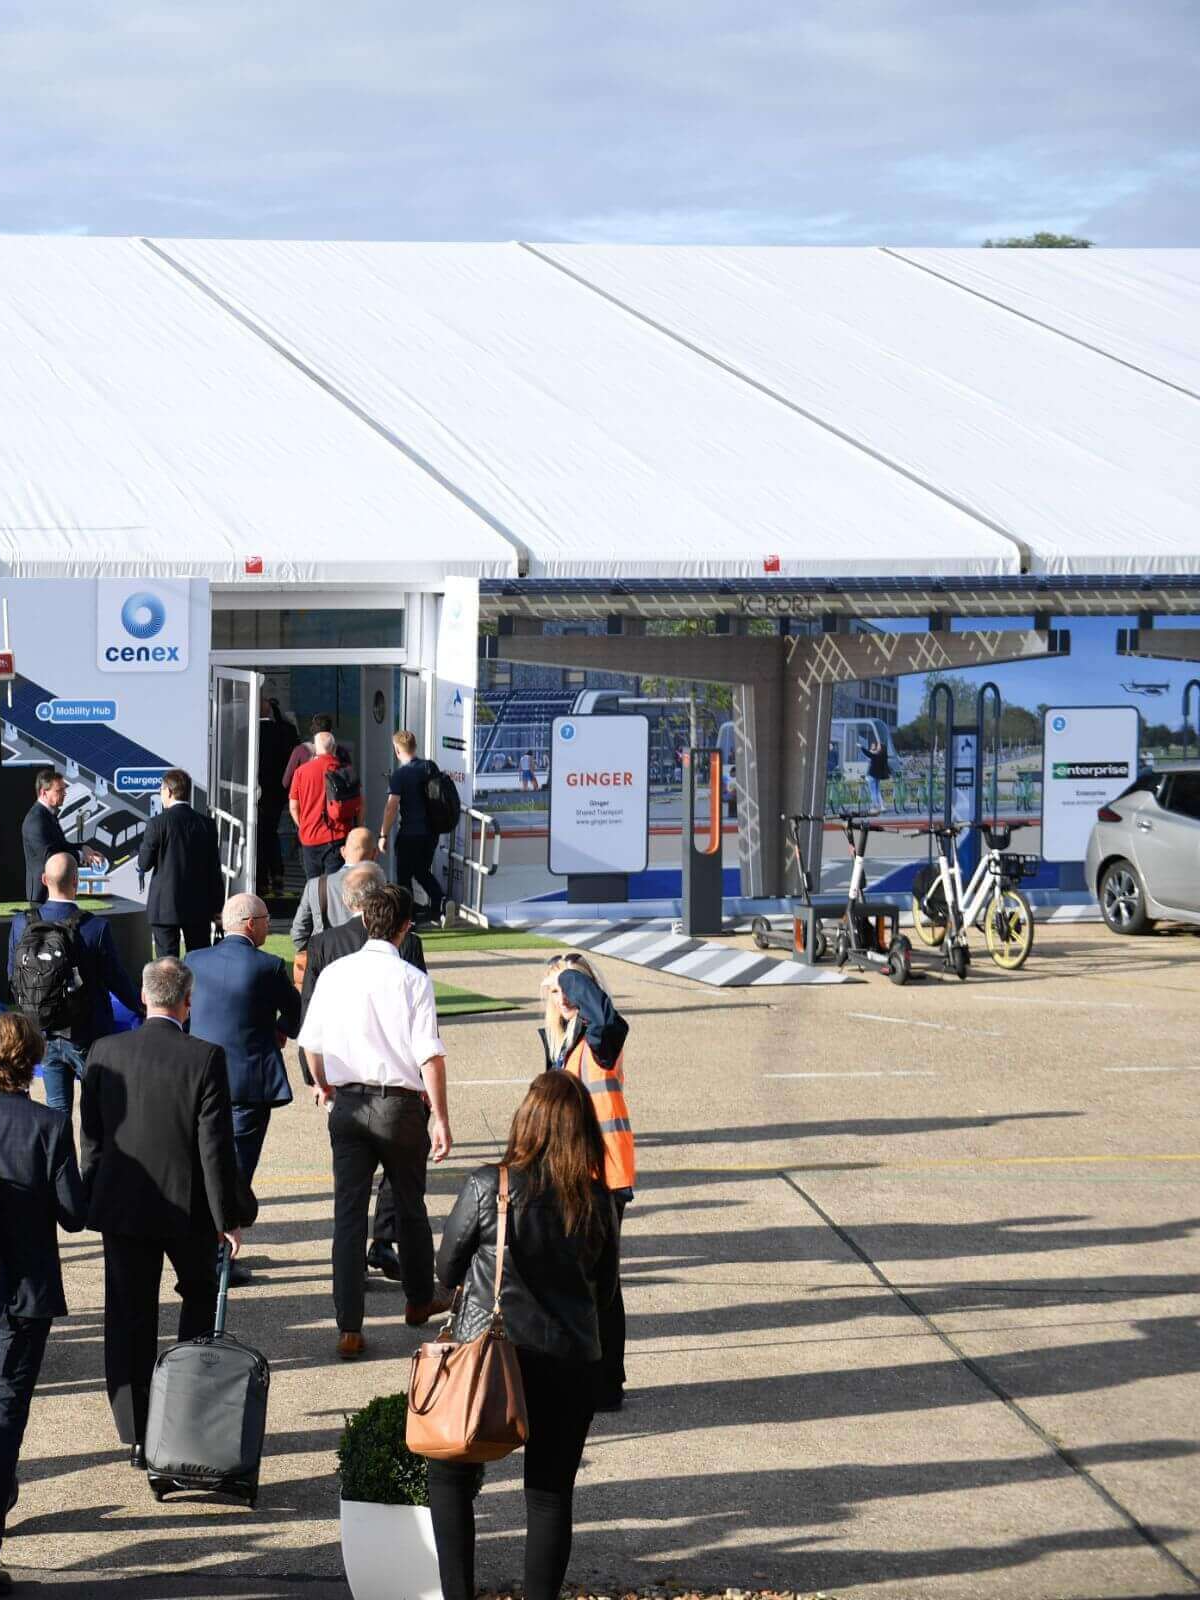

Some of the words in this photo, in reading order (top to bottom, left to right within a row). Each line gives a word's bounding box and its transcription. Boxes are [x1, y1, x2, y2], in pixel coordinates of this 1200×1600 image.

[105, 646, 180, 662] cenex
[56, 706, 90, 717] Mobility
[92, 706, 111, 715] Hub
[1056, 719, 1063, 729] 2
[1056, 764, 1128, 777] enterprise
[567, 772, 633, 787] GINGER
